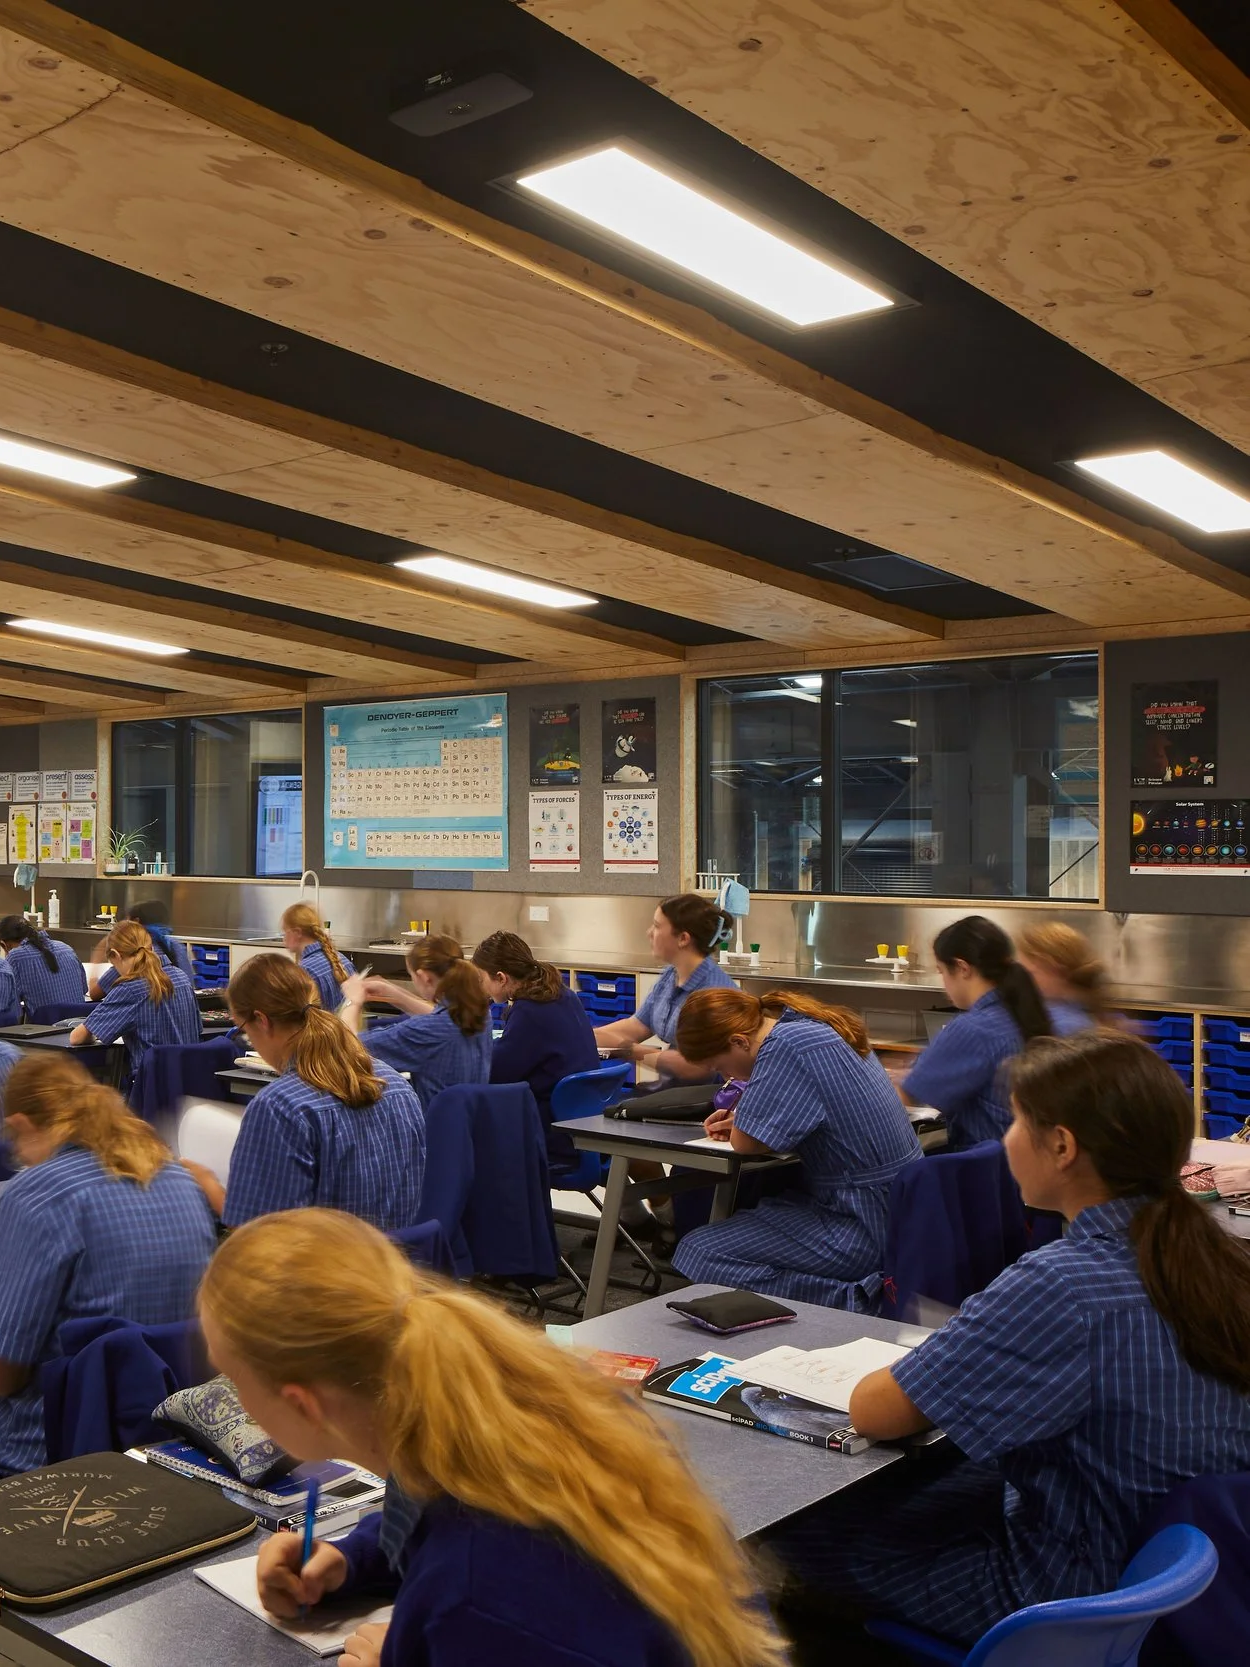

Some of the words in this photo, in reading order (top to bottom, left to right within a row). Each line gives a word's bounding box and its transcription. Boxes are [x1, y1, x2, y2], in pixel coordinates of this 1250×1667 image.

[367, 708, 459, 721] DENOYER-GEPPERT
[46, 773, 67, 781] present
[731, 1416, 754, 1427] sciPAD
[789, 1431, 809, 1442] BOOK
[26, 1472, 113, 1483] MURIWAI
[91, 1486, 147, 1506] WILD
[56, 1535, 125, 1547] CLUB
